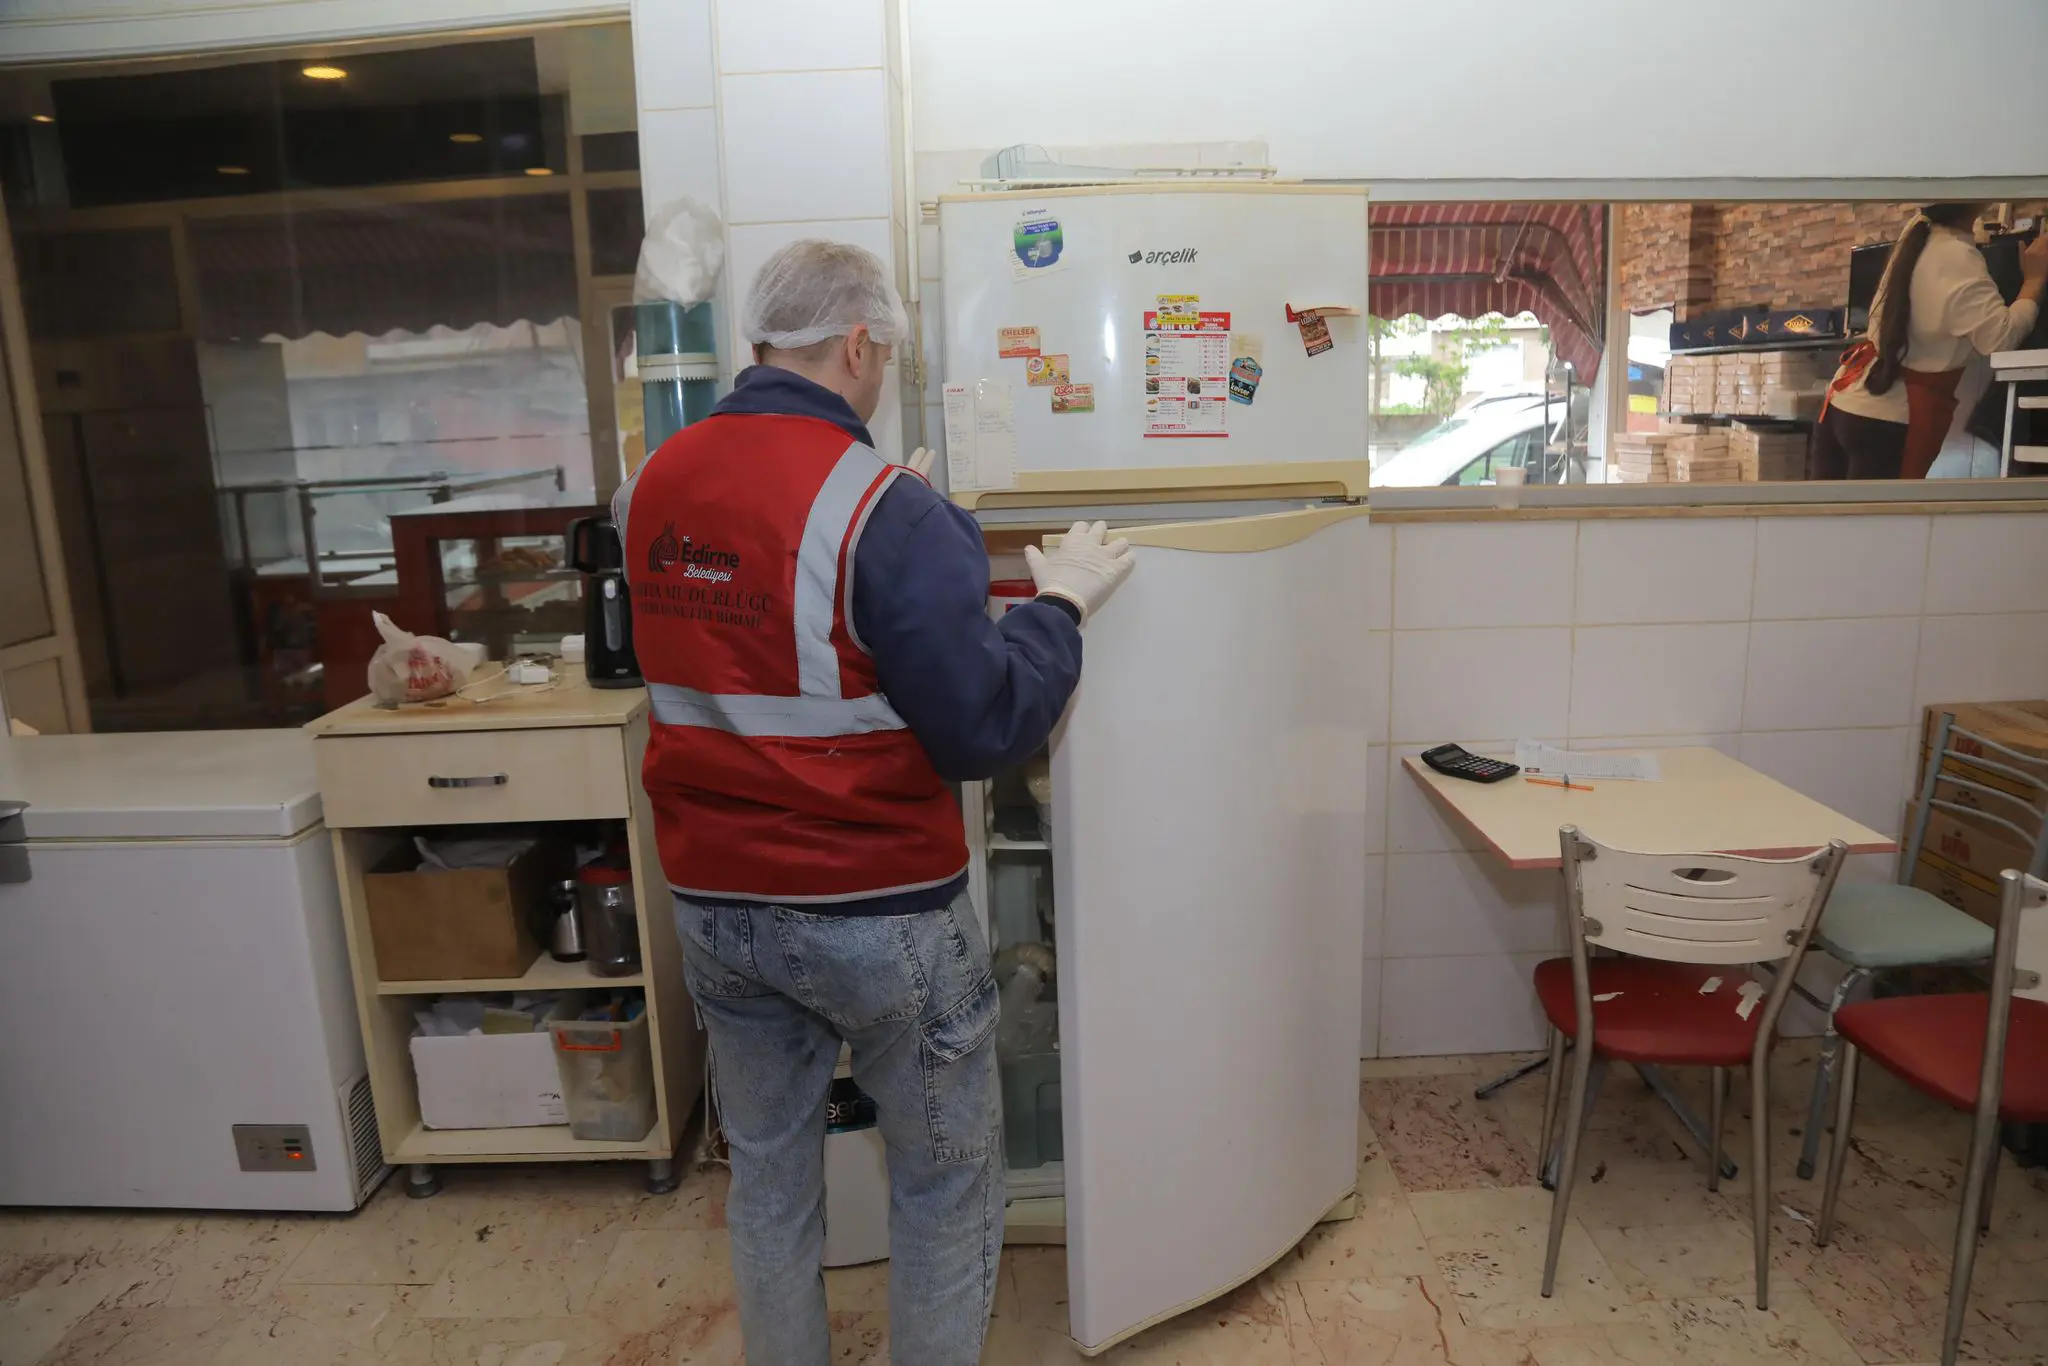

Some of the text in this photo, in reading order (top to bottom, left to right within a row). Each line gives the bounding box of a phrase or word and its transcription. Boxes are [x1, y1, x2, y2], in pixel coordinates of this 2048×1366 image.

[1145, 247, 1198, 266] arçelik
[682, 543, 740, 568] Edirne
[683, 563, 733, 584] Belediyesi
